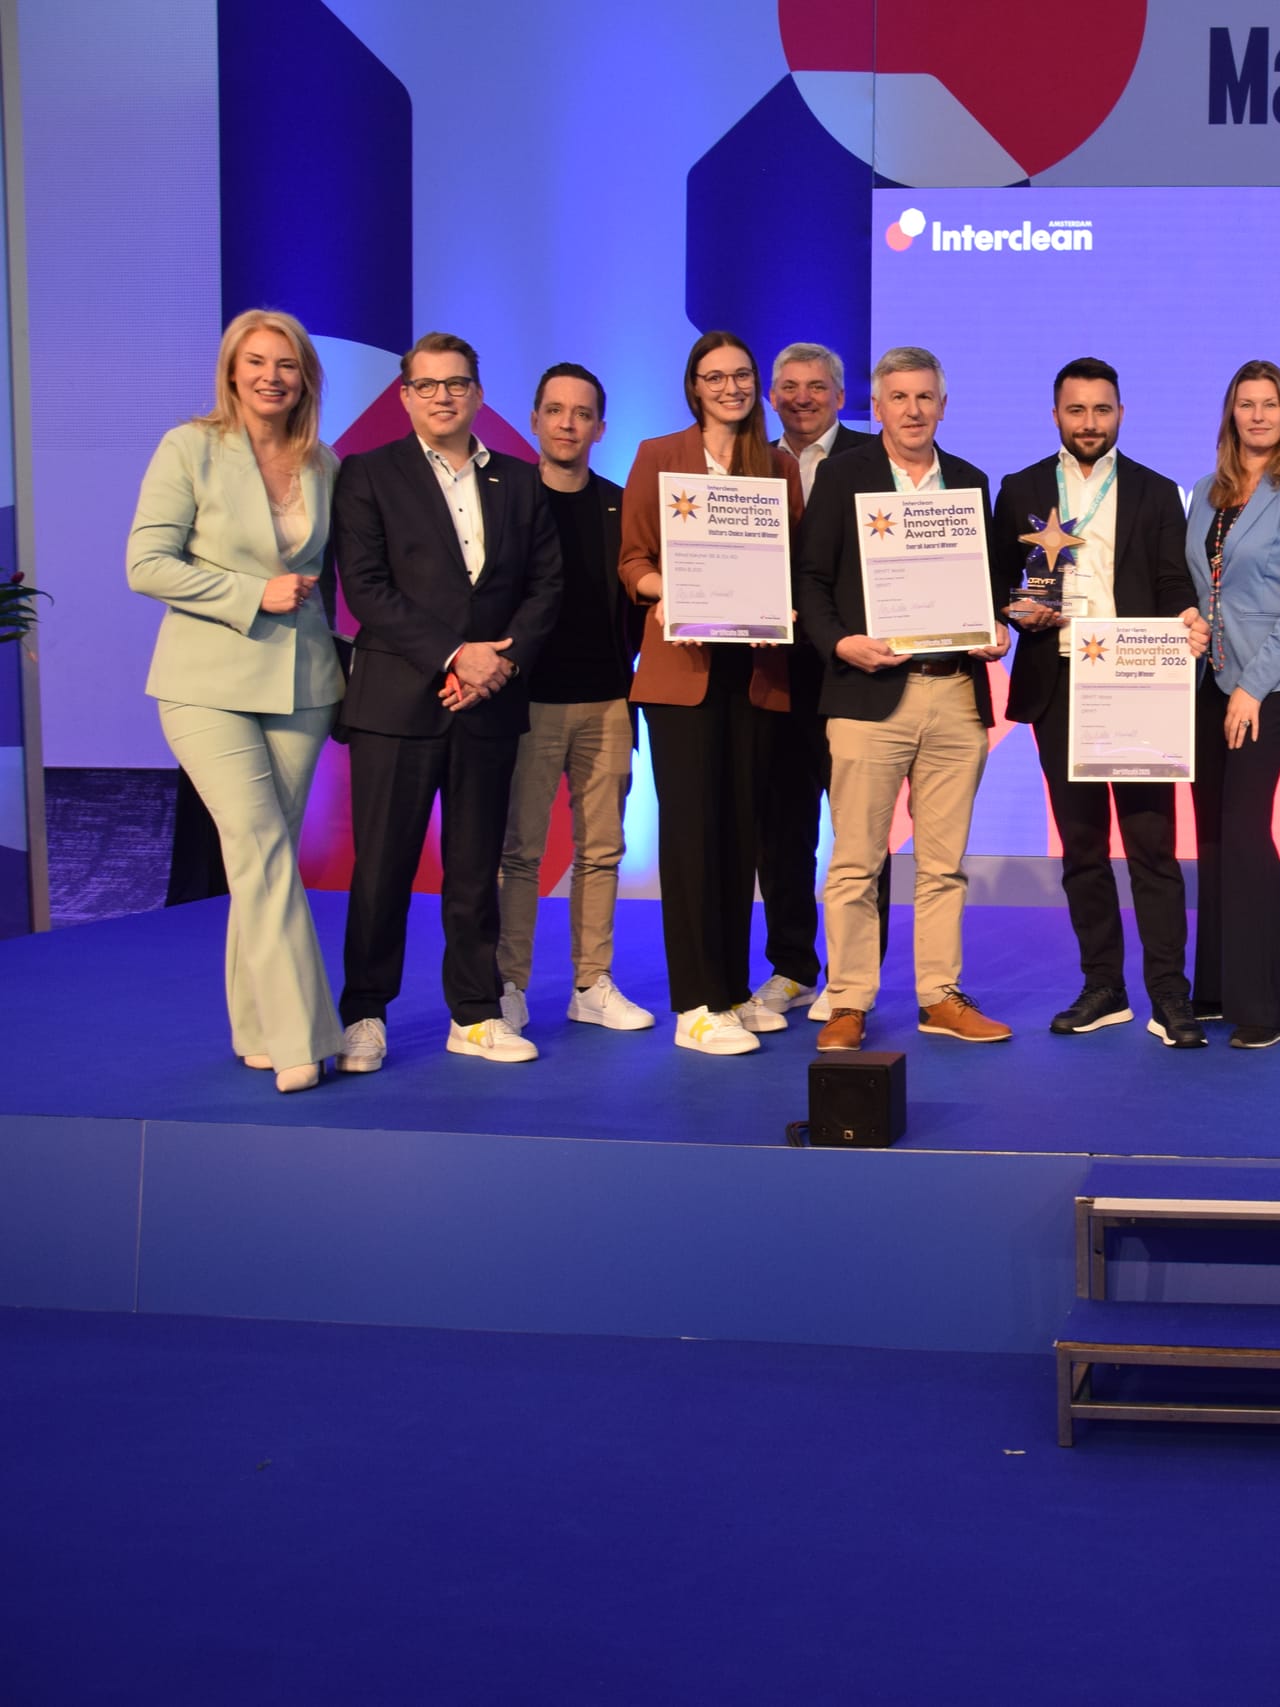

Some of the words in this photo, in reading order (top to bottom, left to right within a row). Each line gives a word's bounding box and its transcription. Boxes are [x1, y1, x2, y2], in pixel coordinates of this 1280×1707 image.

[932, 220, 1093, 251] Interclean
[707, 491, 780, 505] Amsterdam
[708, 503, 772, 516] Innovation
[904, 505, 975, 517] Amsterdam
[708, 514, 749, 526] Award
[754, 518, 780, 527] 2026
[904, 516, 968, 528] Innovation
[905, 528, 946, 539] Award
[951, 528, 977, 536] 2026
[1116, 634, 1188, 644] Amsterdam
[1116, 645, 1180, 655] Innovation
[1116, 656, 1156, 665] Award
[1161, 657, 1187, 666] 2026
